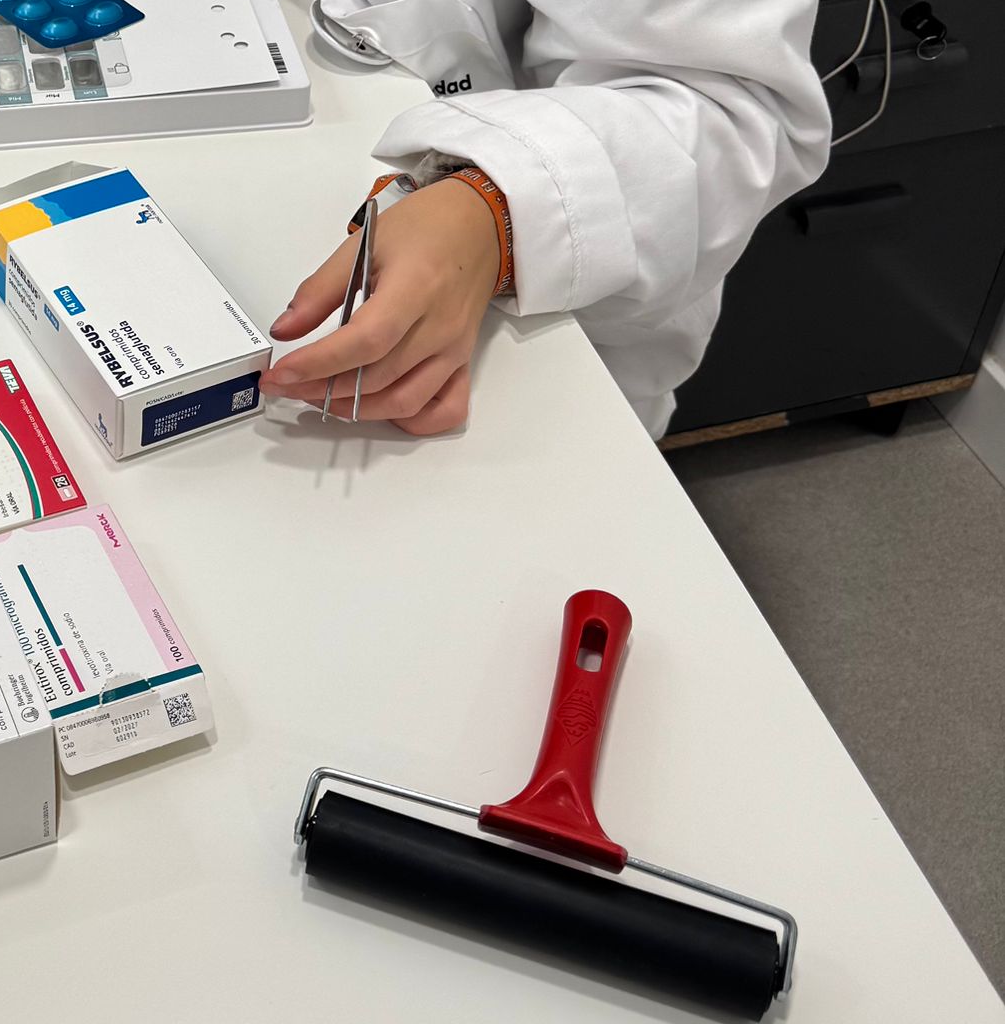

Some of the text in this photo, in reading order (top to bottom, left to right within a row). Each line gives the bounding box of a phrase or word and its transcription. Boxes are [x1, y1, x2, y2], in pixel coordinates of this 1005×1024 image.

[59, 289, 73, 302] mg
[66, 302, 79, 312] 14
[223, 300, 262, 345] 30 comprimidos
[108, 328, 151, 380] comprimidos
[119, 320, 165, 375] semaglutida
[163, 345, 185, 369] Vía oral
[54, 476, 68, 487] 28
[6, 491, 17, 506] ORAL
[18, 636, 35, 656] 100
[63, 612, 101, 679] levotiroxina de sodio
[152, 608, 184, 662] 100 comprimidos
[34, 628, 74, 696] comprimidos
[96, 649, 109, 663] oral
[7, 674, 30, 707] Boehringer
[11, 674, 34, 705] Ingelheim
[63, 721, 138, 750] CAD 02/2027
[65, 751, 77, 759] Lote
